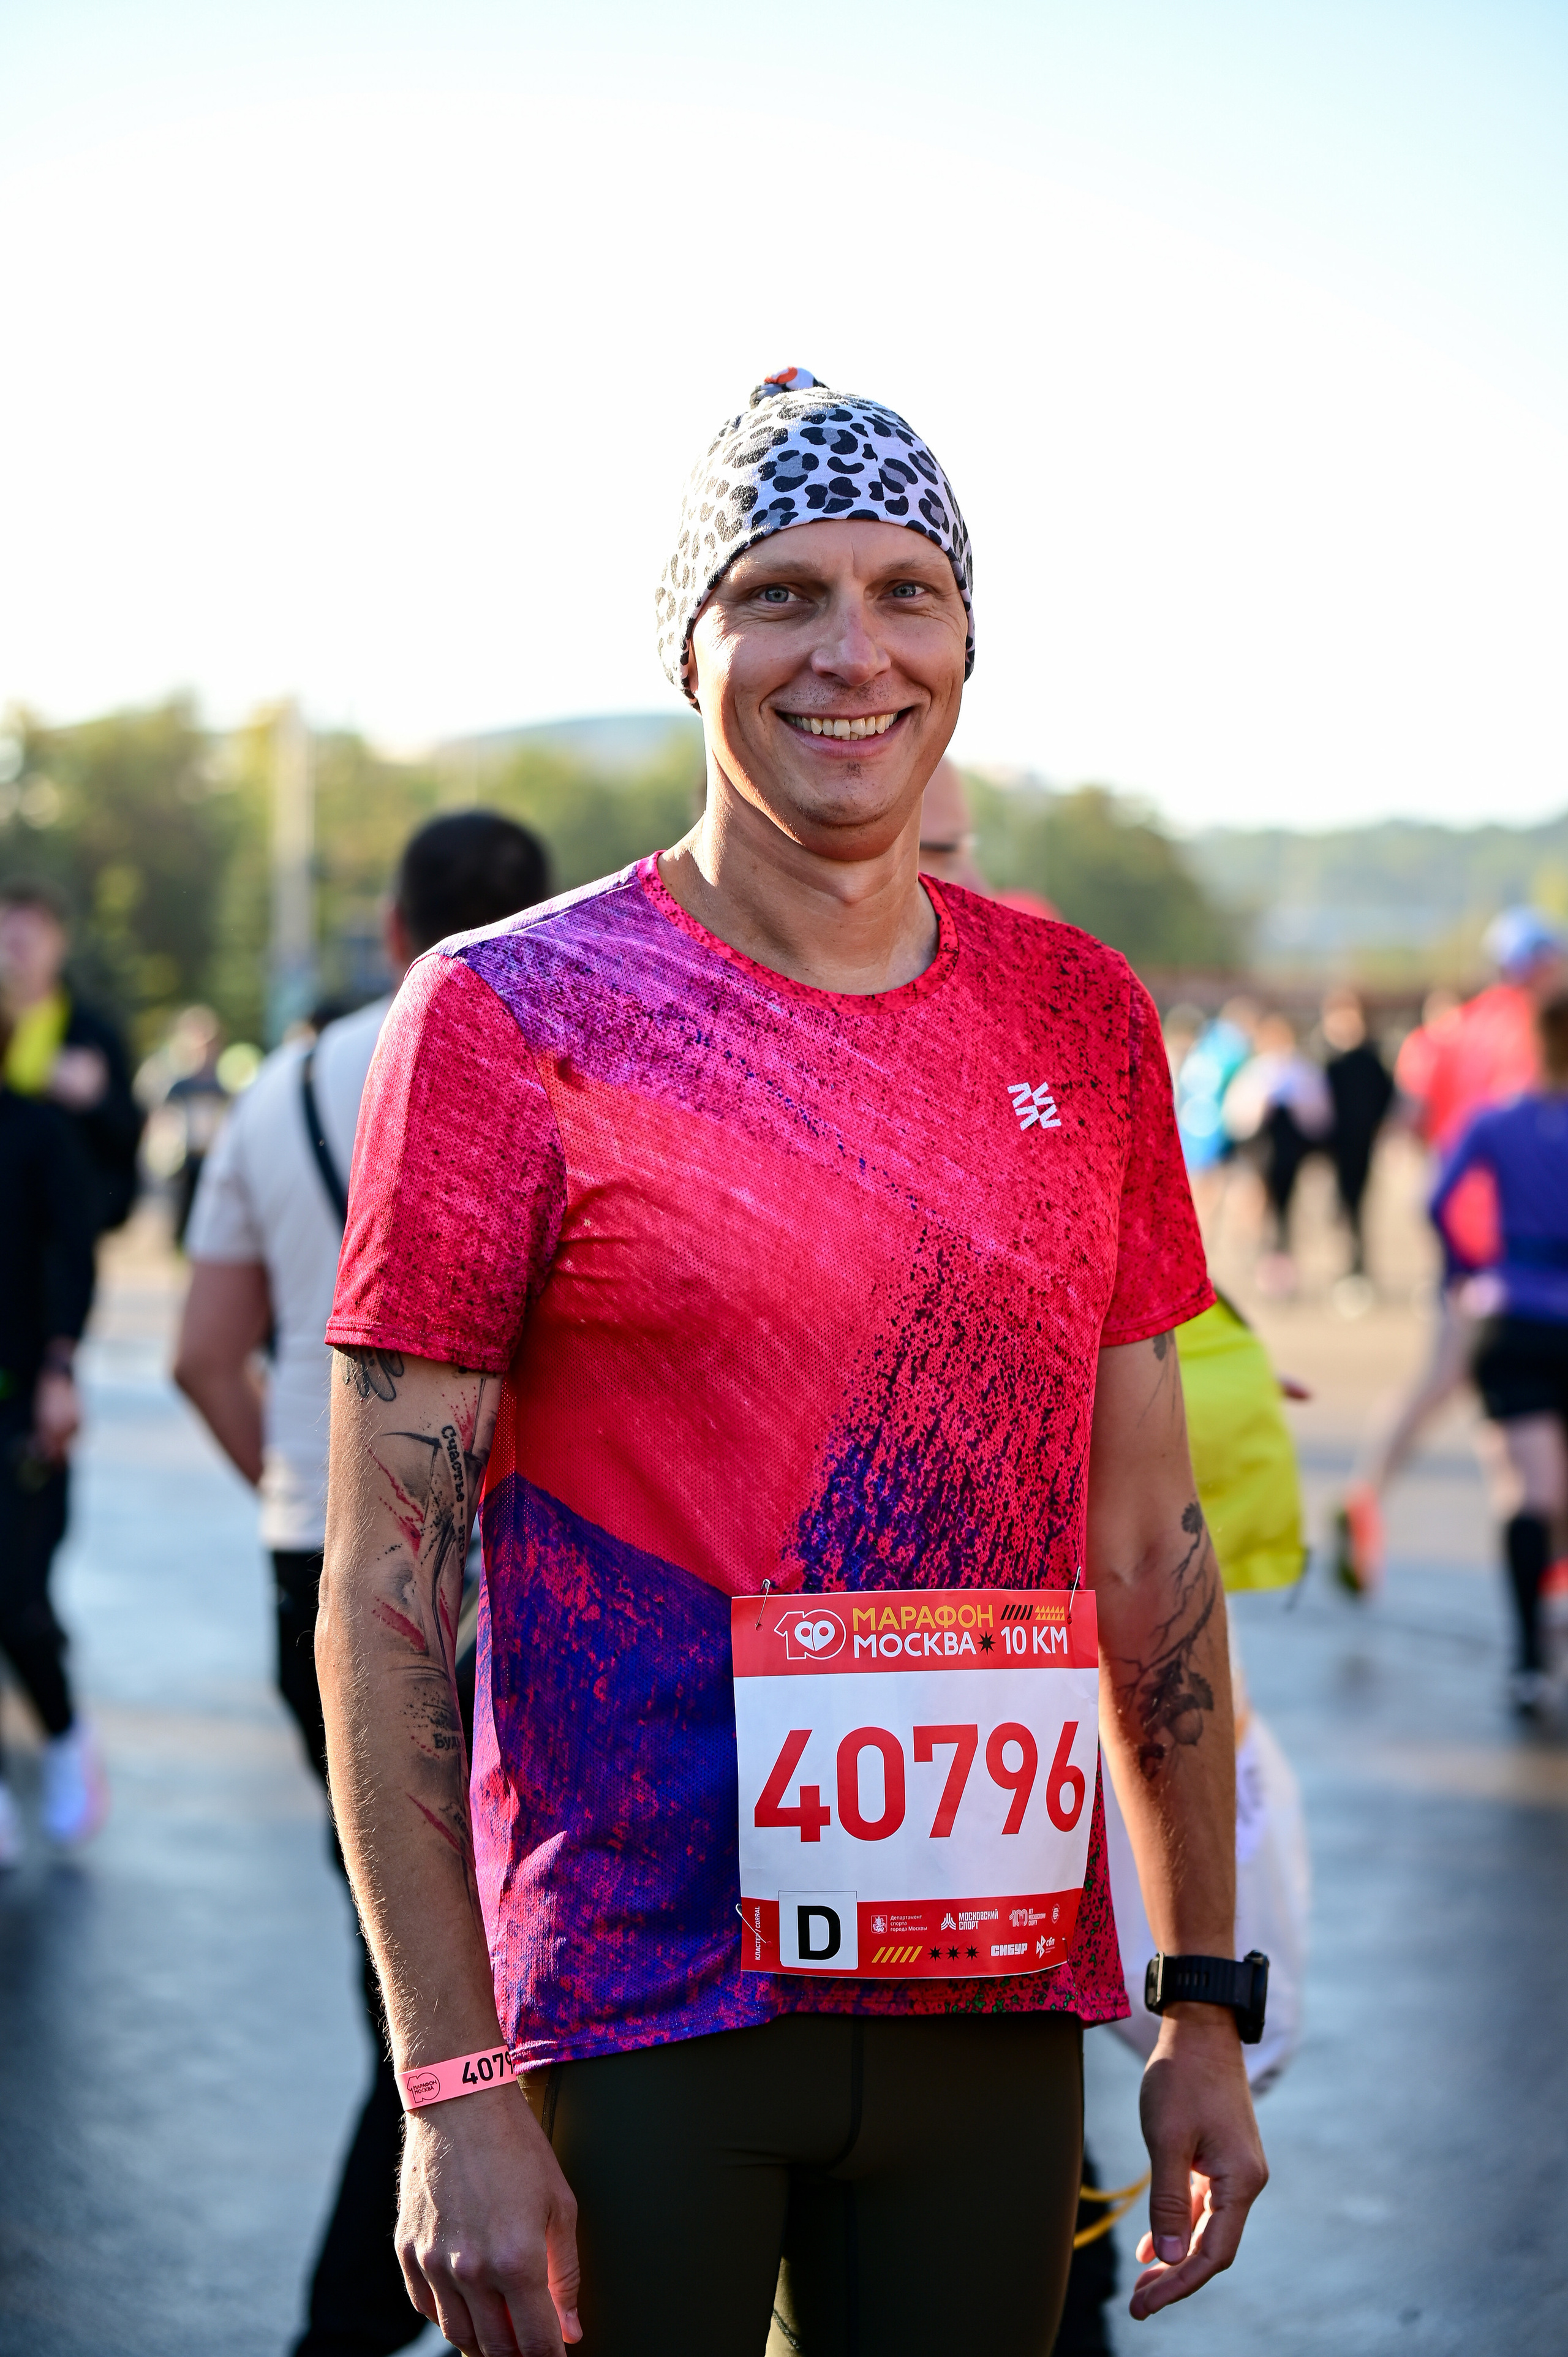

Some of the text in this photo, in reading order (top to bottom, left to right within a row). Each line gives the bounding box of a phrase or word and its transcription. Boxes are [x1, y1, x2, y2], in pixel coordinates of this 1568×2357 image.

[442, 1425, 464, 1502] Счастье
[853, 1605, 993, 1632] МАРАФОН
[854, 1625, 1068, 1659] МОСКВА 10 КМ
[754, 1721, 1085, 1842] 40796
[959, 1909, 998, 1921] МОСКОВСКИЙ
[797, 1905, 841, 1960] D
[959, 1921, 979, 1931] СПОРТ
[1046, 1937, 1055, 1947] сбп
[990, 1943, 1028, 1957] СИБУР
[413, 2079, 437, 2090] МАРАФОН
[415, 2086, 434, 2095] МОСКВА
